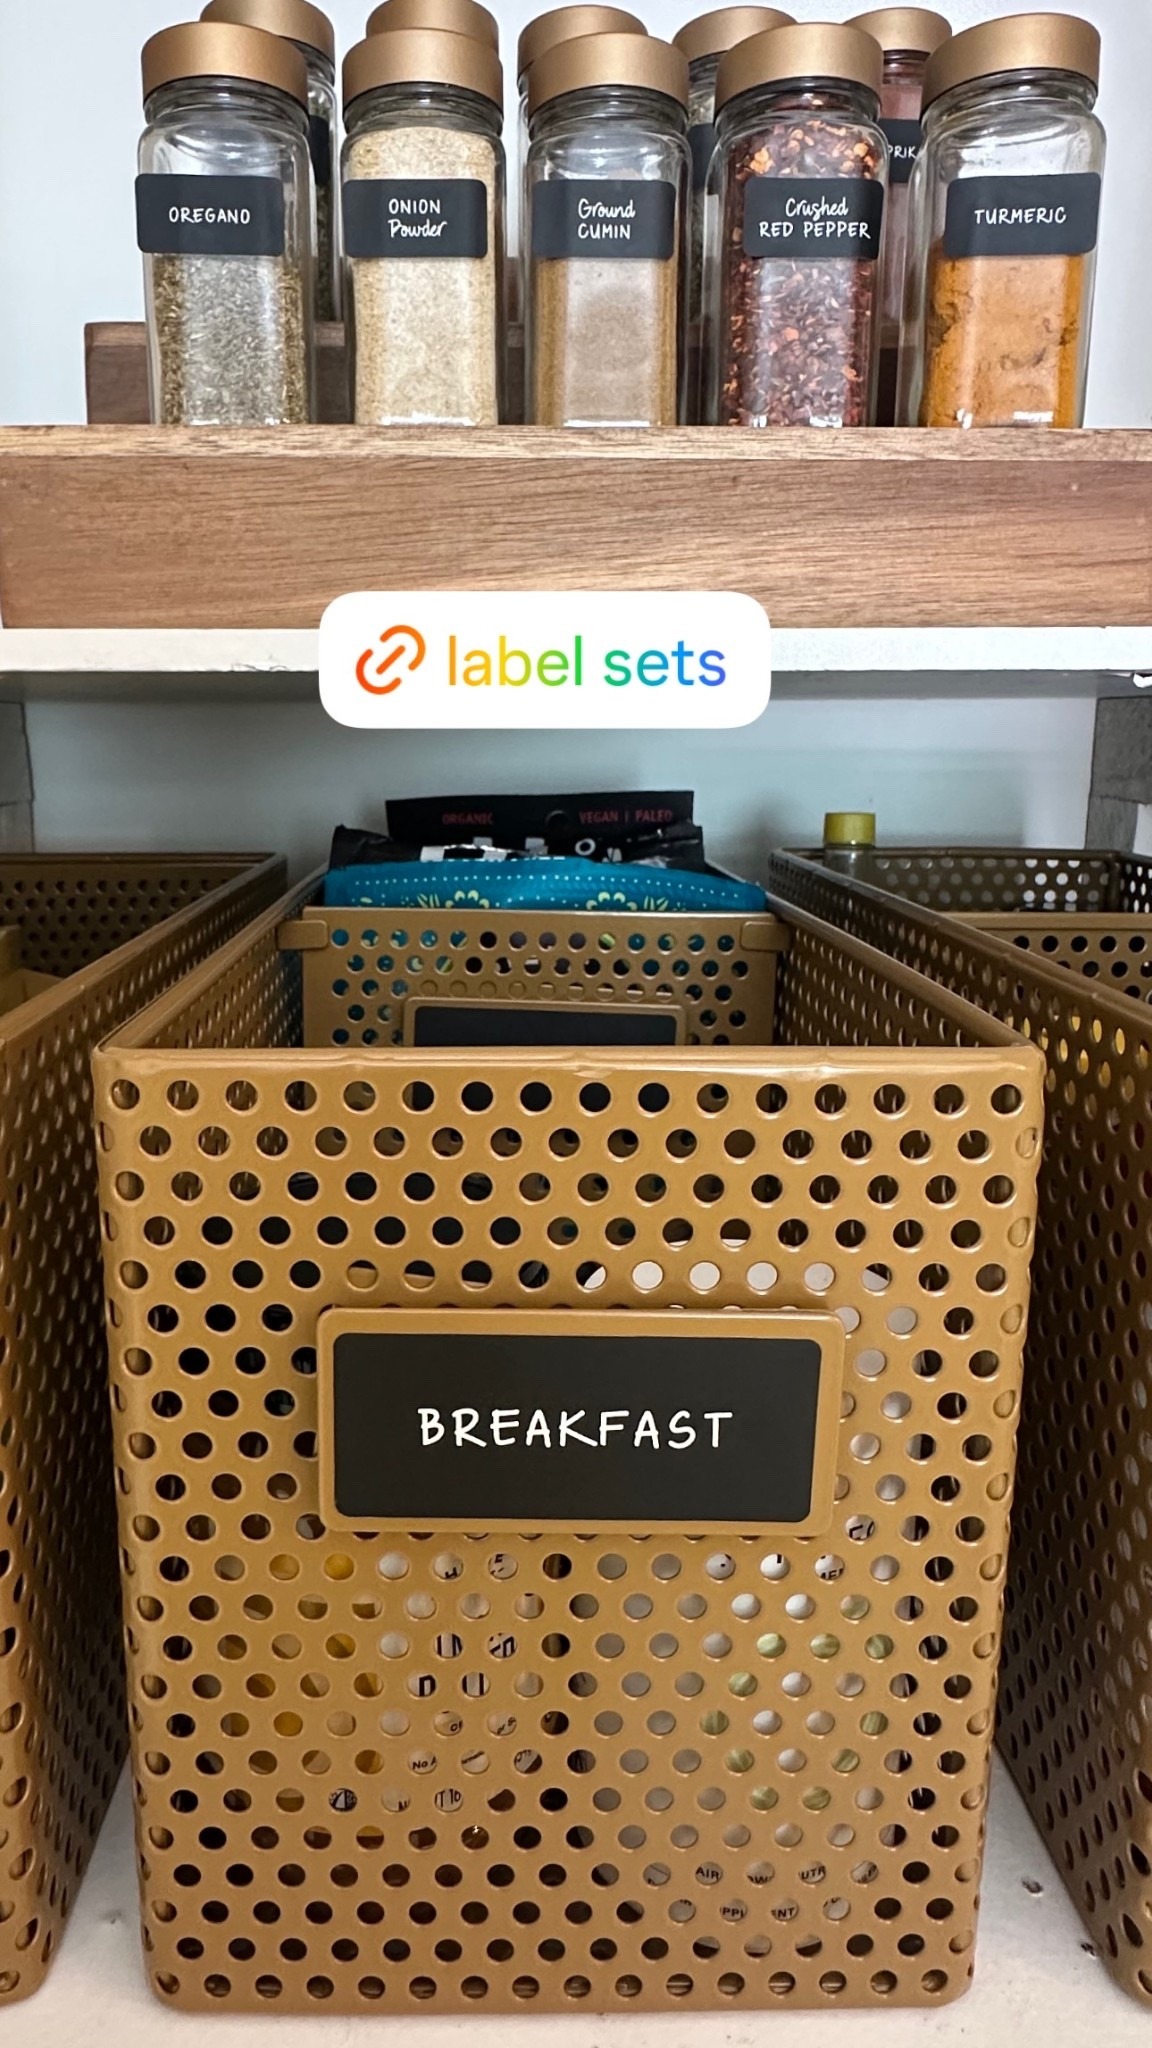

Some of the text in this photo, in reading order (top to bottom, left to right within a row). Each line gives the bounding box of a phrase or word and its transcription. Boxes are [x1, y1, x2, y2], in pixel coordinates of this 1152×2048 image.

[168, 206, 251, 224] OREGANO
[388, 198, 441, 215] ONION
[578, 198, 636, 219] Ground
[785, 195, 849, 221] Crushed
[974, 206, 1067, 225] TURMERIC
[387, 218, 448, 239] Powder
[577, 222, 631, 240] CUMIN
[759, 220, 871, 239] RED PEPPER
[442, 812, 494, 825] ORGANIC
[579, 809, 673, 824] VEGAN PALEO
[417, 1407, 733, 1449] BREAKFAST
